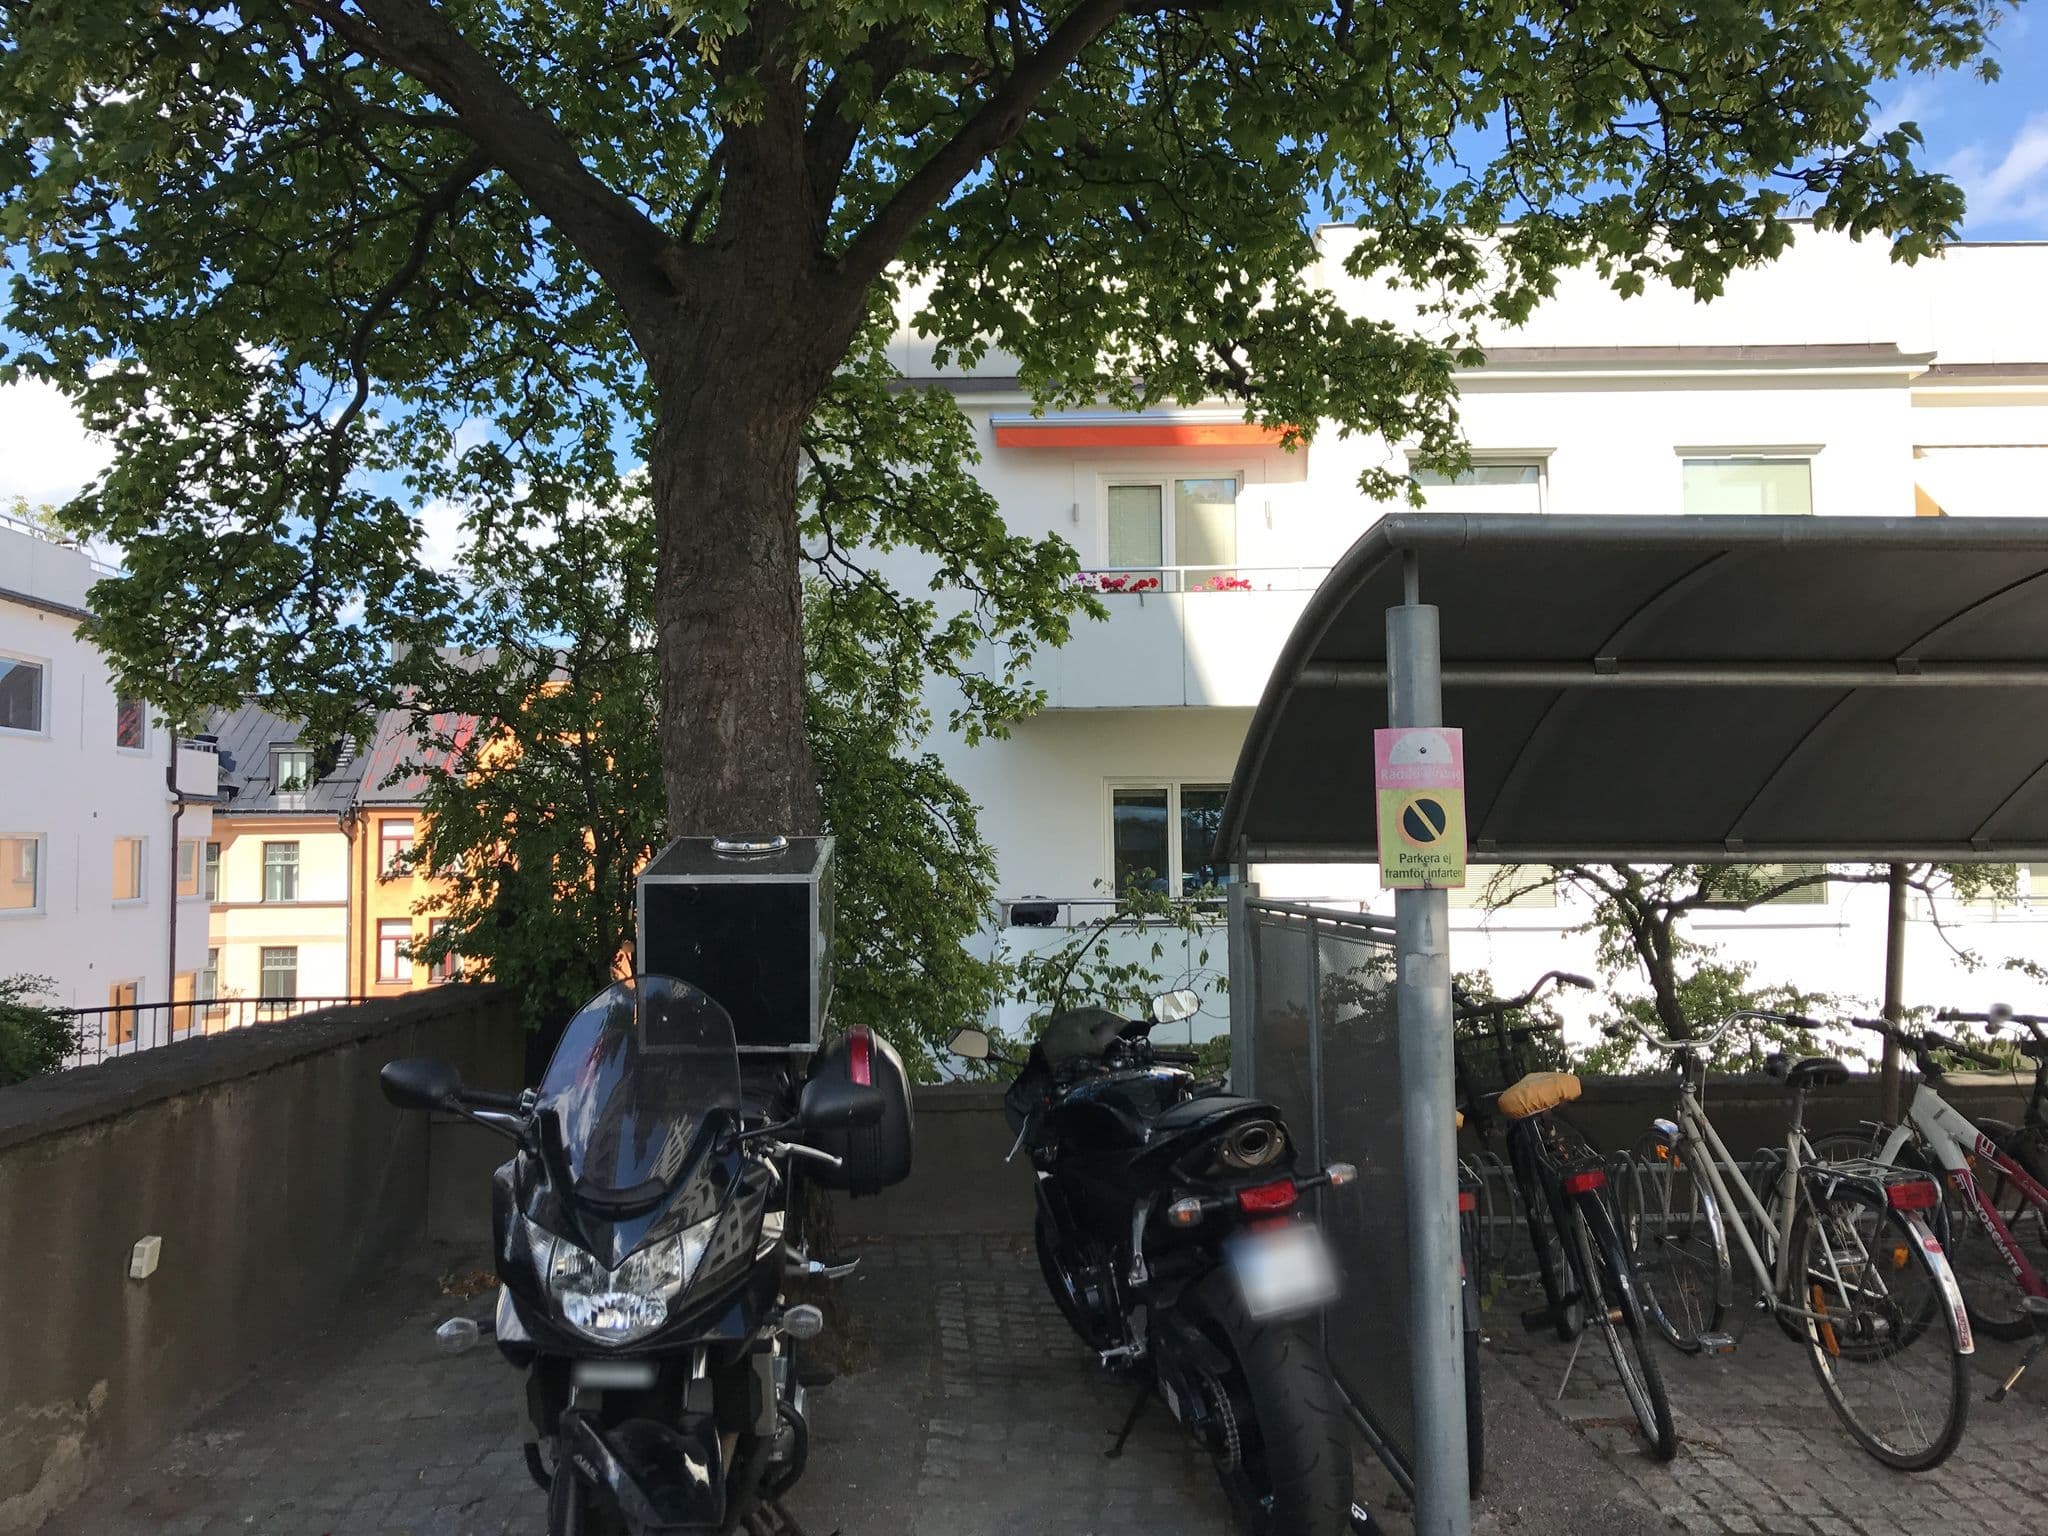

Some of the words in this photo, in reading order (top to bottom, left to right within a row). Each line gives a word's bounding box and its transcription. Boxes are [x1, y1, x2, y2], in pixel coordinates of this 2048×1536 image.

[1399, 853, 1440, 864] Parkera
[1443, 853, 1452, 865] ej
[1385, 868, 1425, 879] framför
[1428, 867, 1462, 878] infarten
